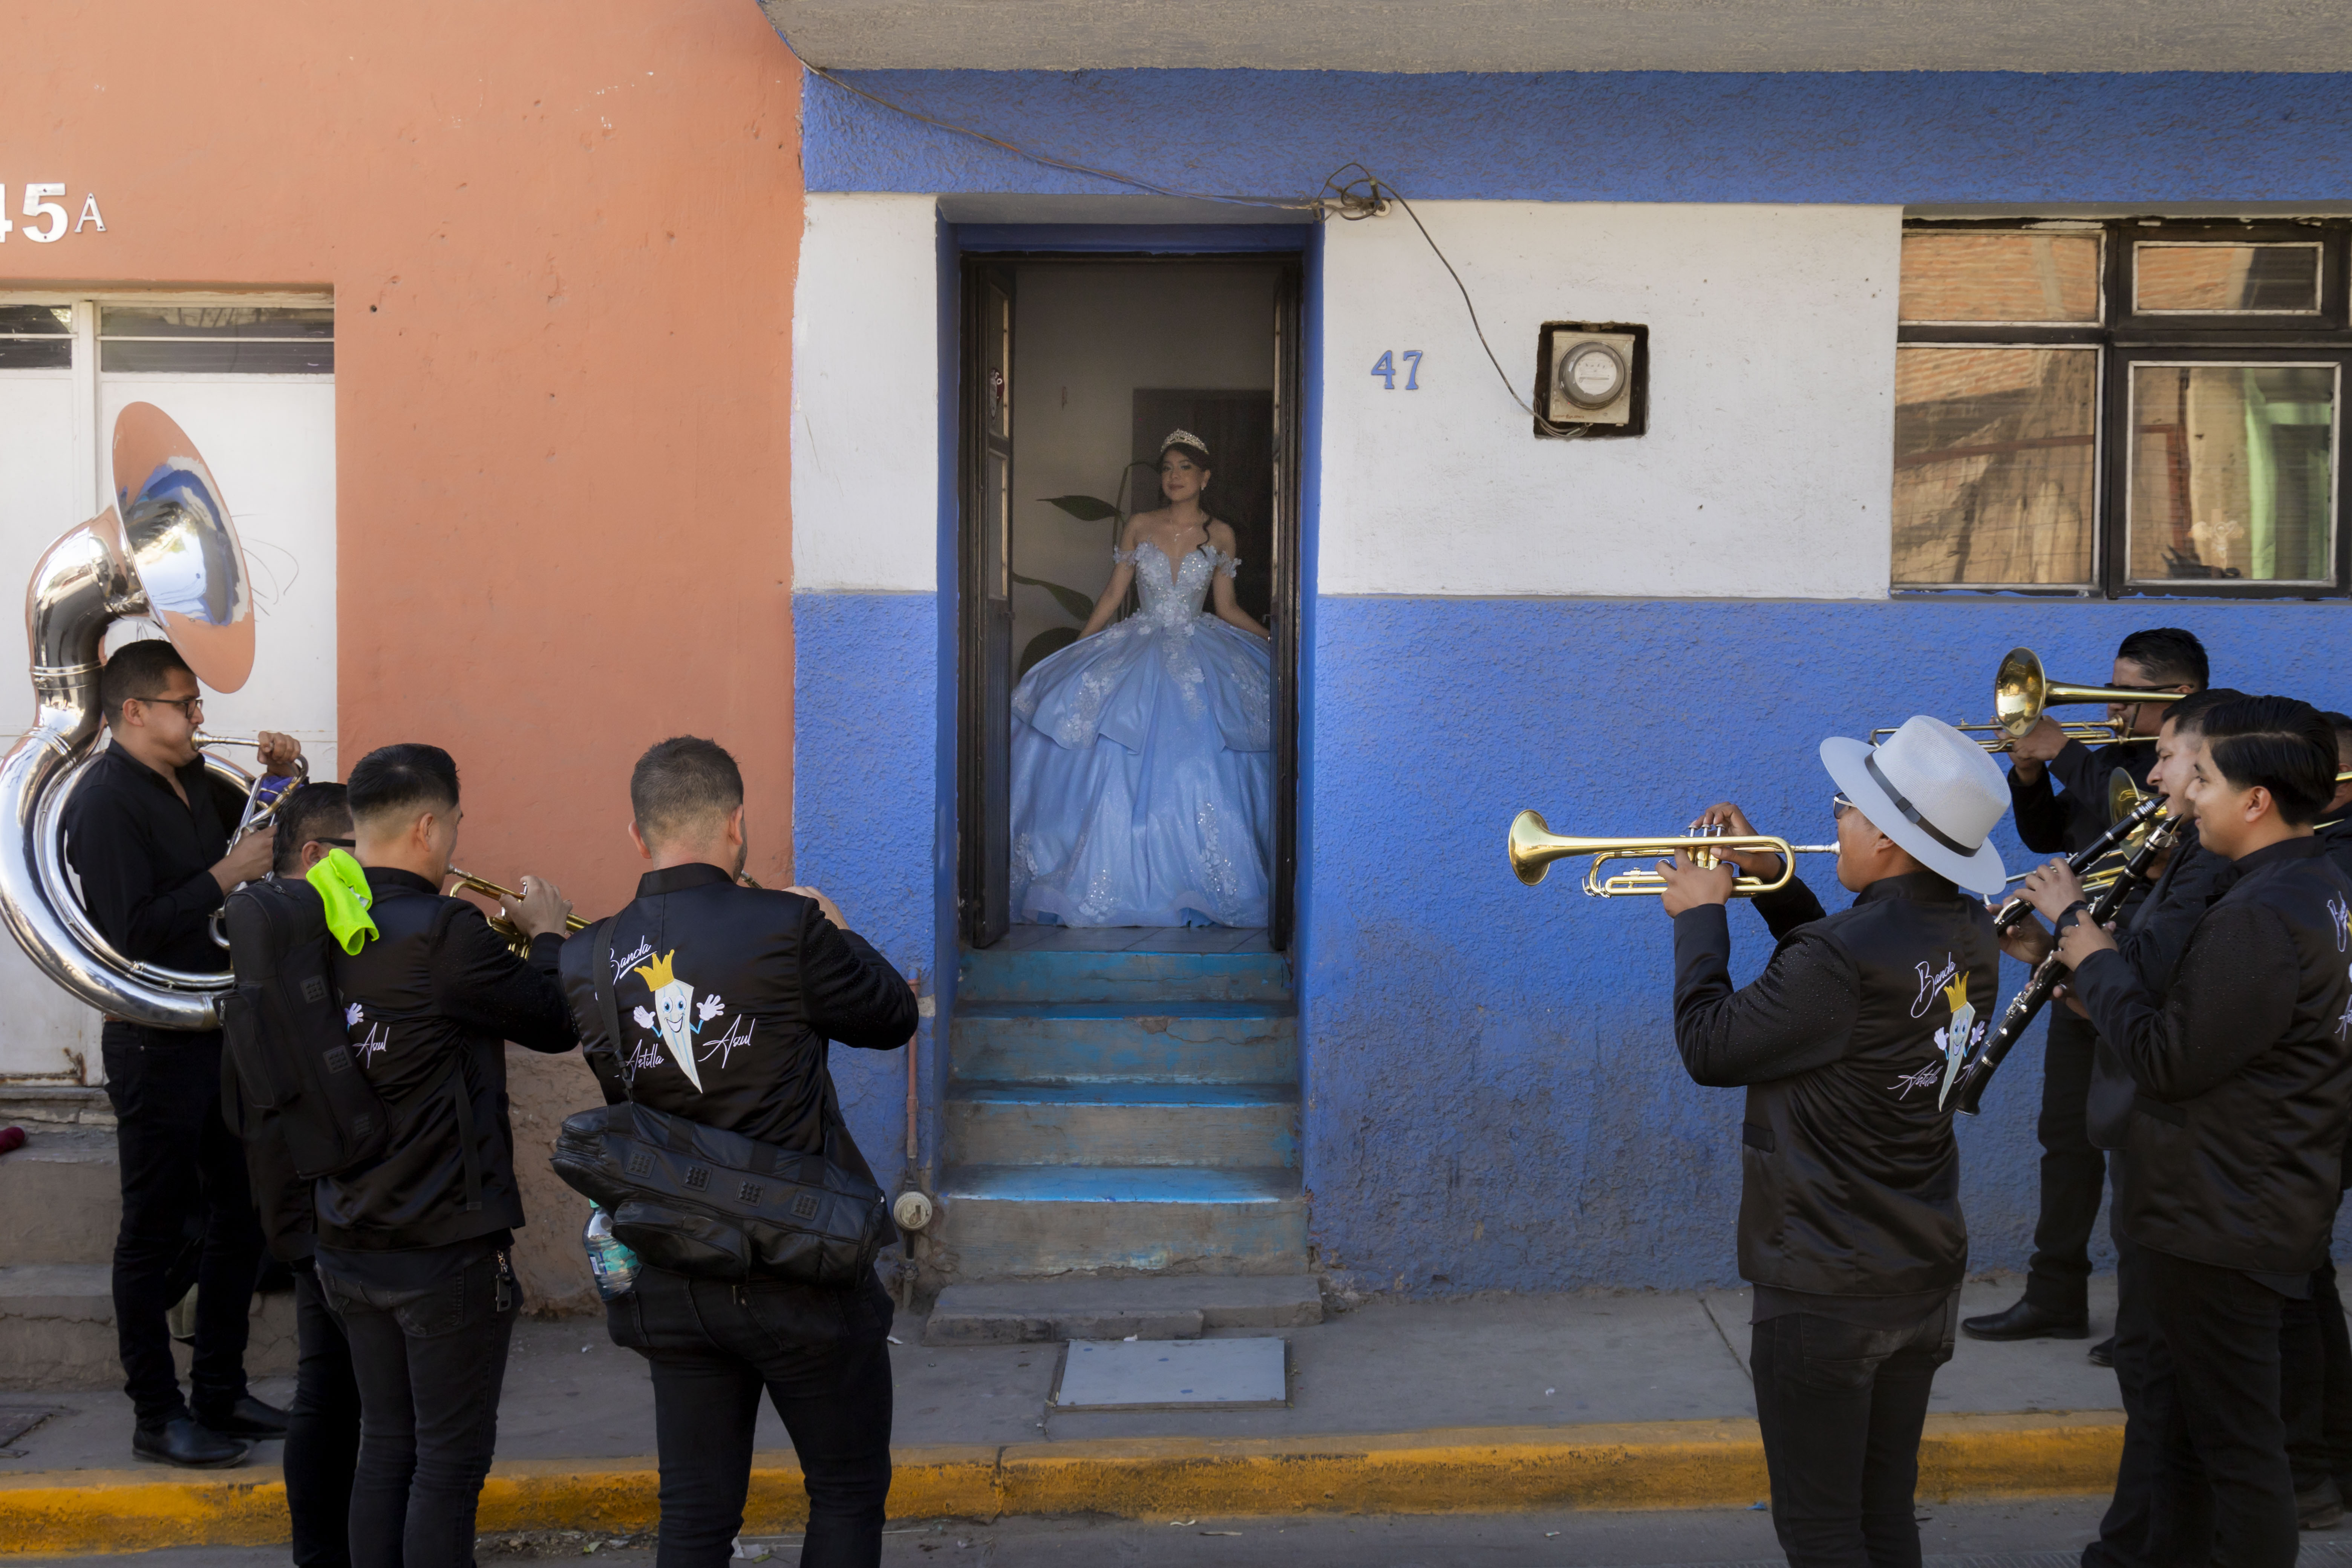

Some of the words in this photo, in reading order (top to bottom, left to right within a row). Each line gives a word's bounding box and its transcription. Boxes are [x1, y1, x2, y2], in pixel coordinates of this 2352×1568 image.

[1370, 350, 1423, 390] 47
[1911, 952, 1956, 1018] Banda
[352, 1021, 390, 1069] Azul
[698, 1014, 756, 1069] Azul
